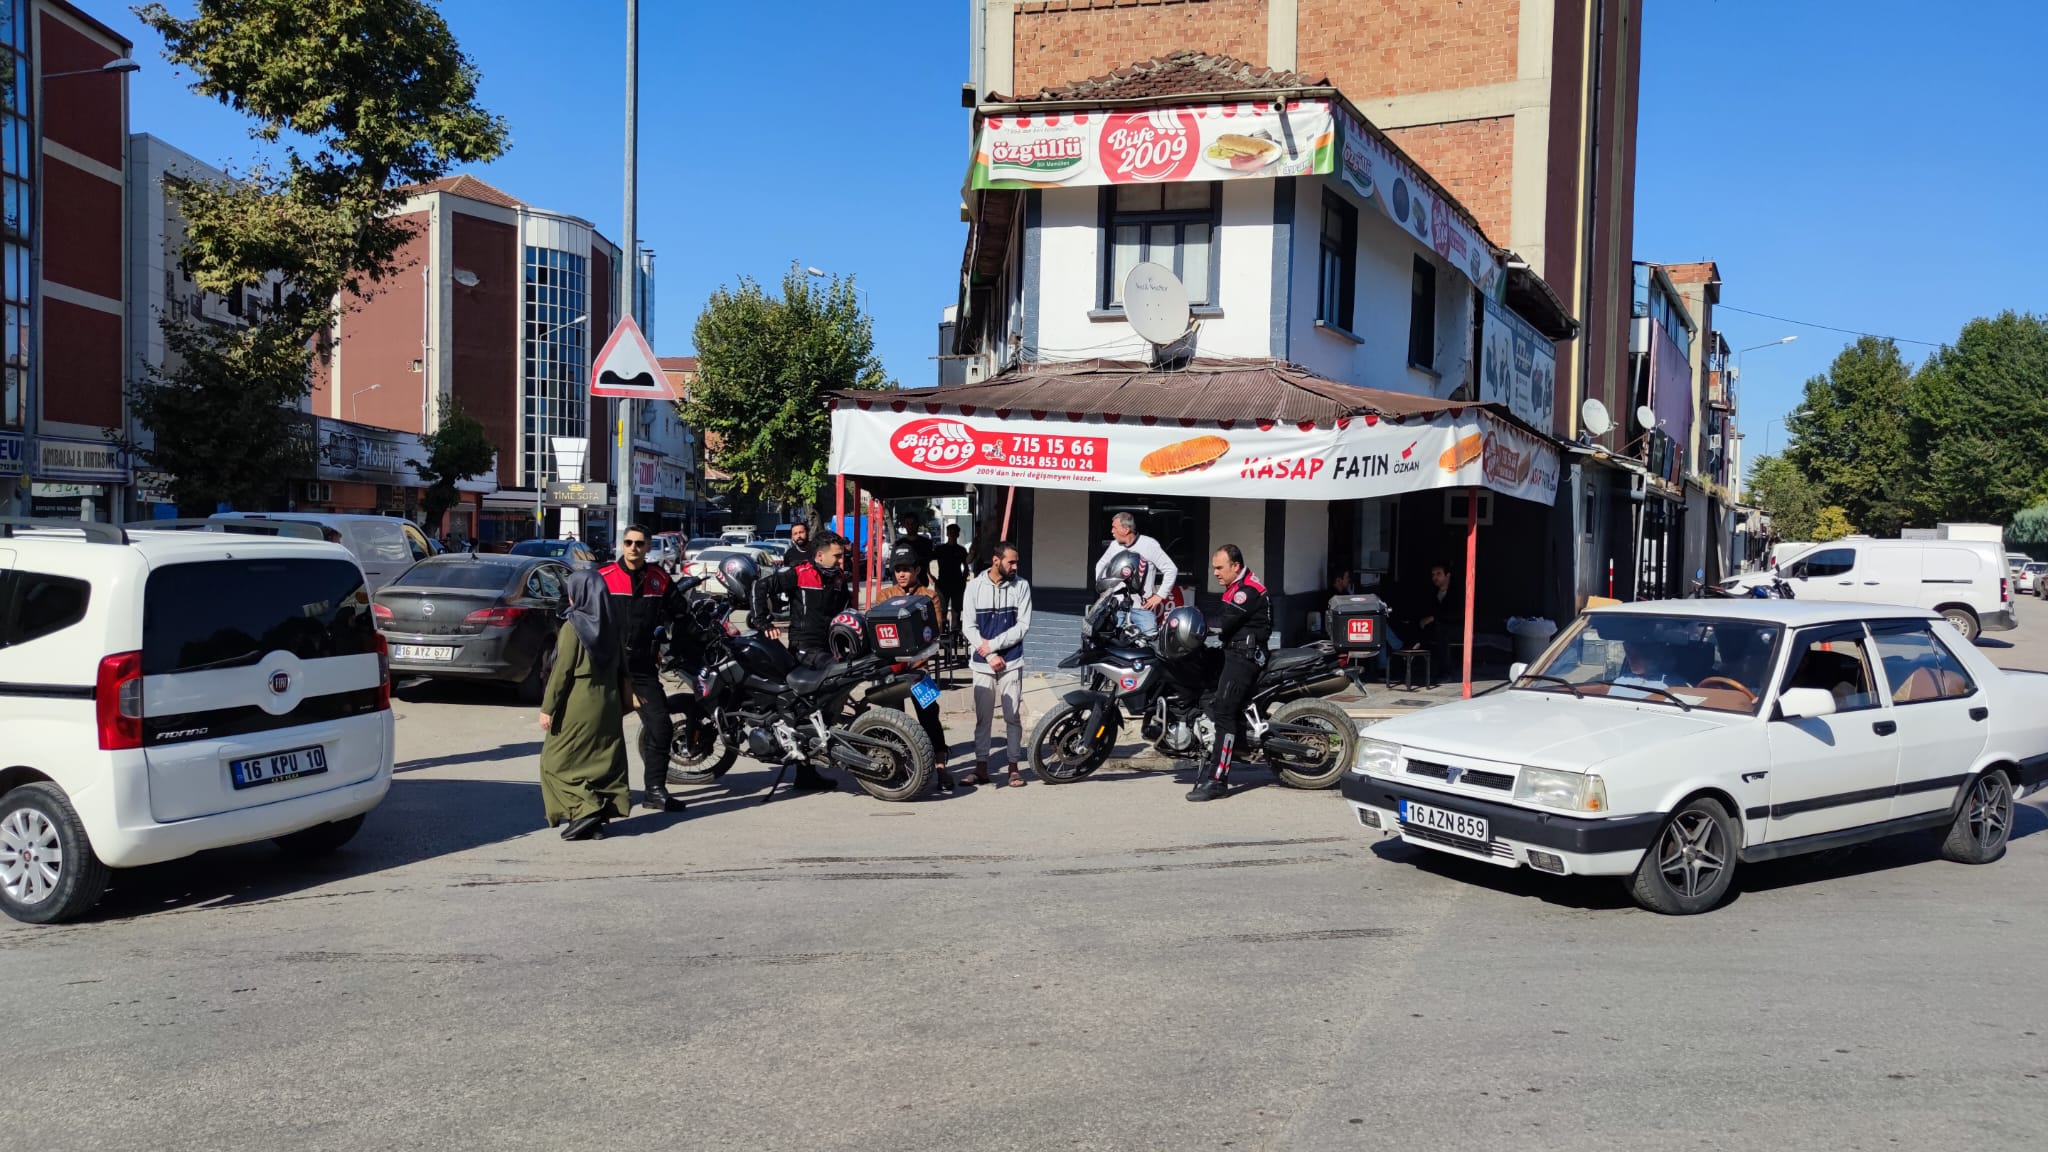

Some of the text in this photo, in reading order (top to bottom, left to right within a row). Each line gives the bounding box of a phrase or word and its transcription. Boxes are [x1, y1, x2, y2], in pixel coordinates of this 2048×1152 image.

[1107, 127, 1155, 150] Büfe
[993, 137, 1082, 165] özgüllü
[1117, 136, 1188, 174] 2009
[897, 433, 945, 449] Büfe
[1012, 436, 1094, 456] 715 15 66
[912, 443, 976, 463] 2009
[1009, 455, 1093, 470] 0534 853 00 24
[1240, 454, 1420, 480] KASAP FATIN ÖZKAN
[879, 627, 895, 638] 112
[1352, 621, 1369, 633] 112
[401, 646, 451, 657] 16 AYZ 677
[275, 675, 288, 689] FIAT
[243, 760, 262, 780] 16
[271, 754, 299, 775] KPU
[306, 749, 324, 768] 10
[1409, 804, 1485, 839] 16 AZN 859
